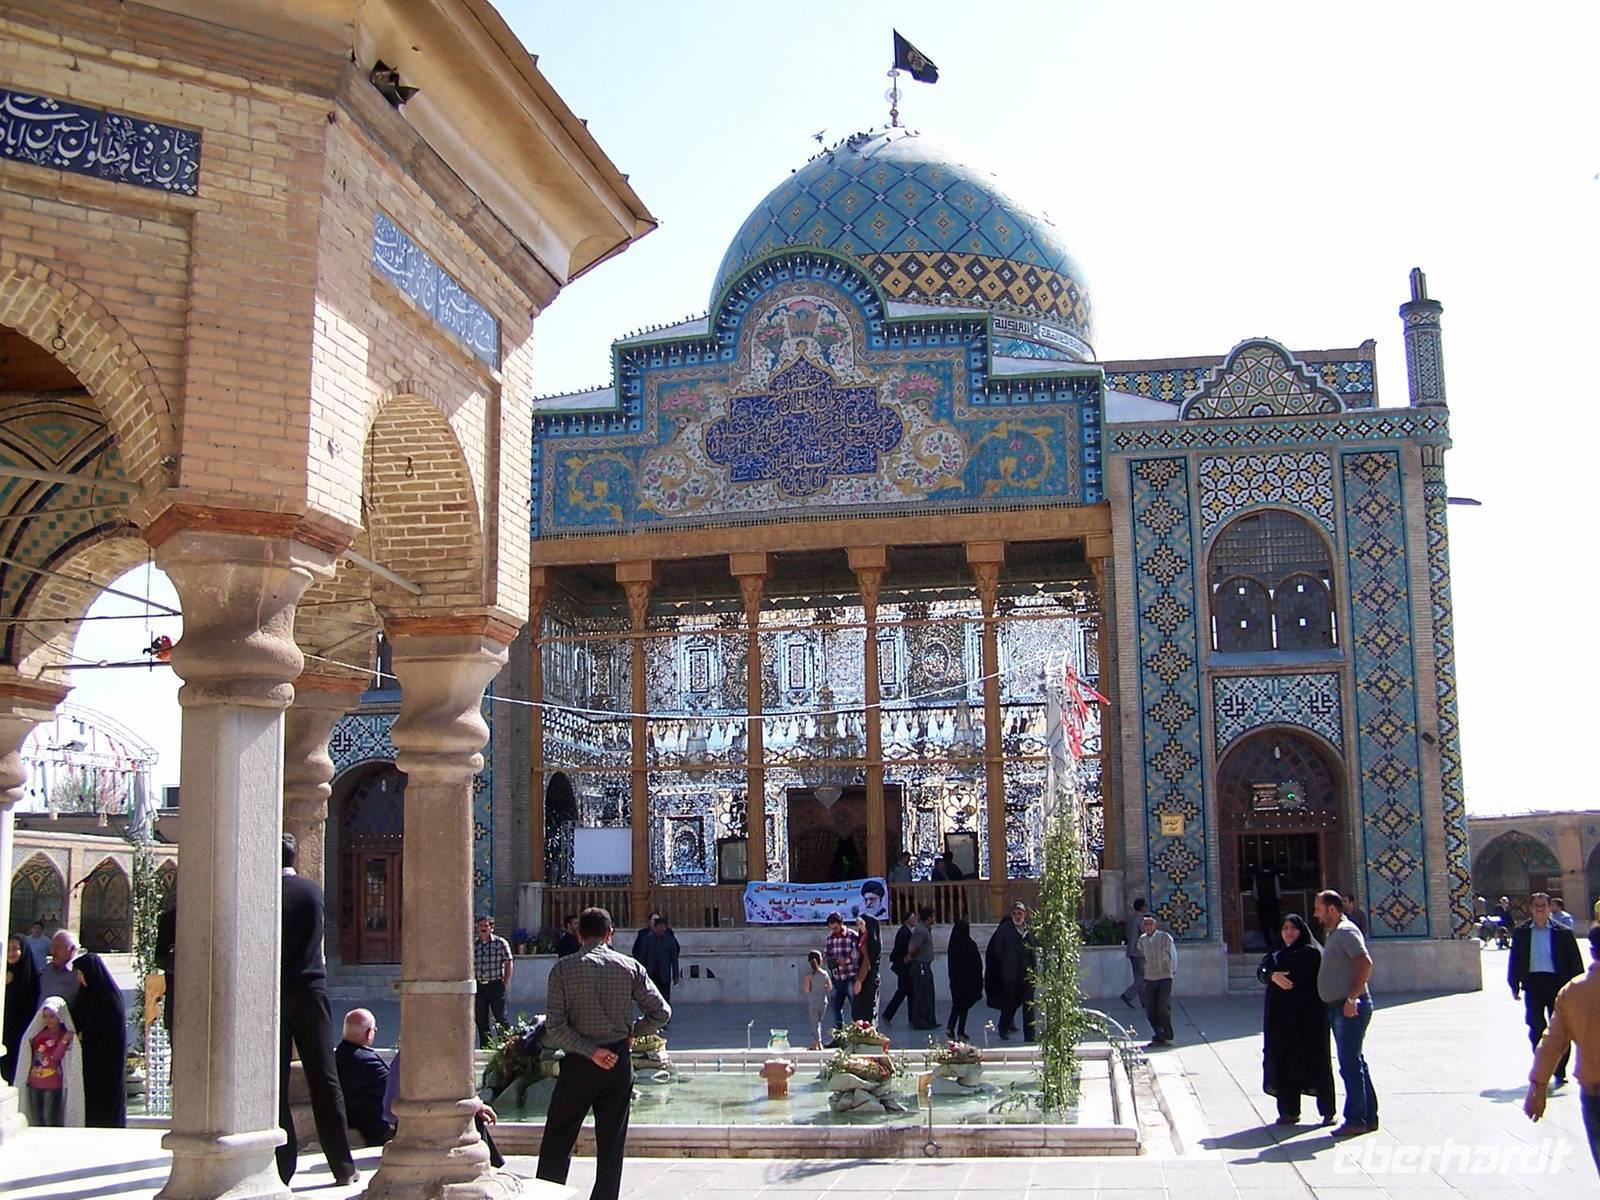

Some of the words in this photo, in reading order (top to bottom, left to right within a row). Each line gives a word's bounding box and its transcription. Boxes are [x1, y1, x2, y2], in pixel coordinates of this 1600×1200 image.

[26, 119, 90, 166] حسین
[58, 120, 131, 168] مظلومان
[844, 883, 860, 891] سال
[768, 897, 782, 905] باد
[784, 897, 808, 907] مبارک
[810, 896, 834, 906] همگان
